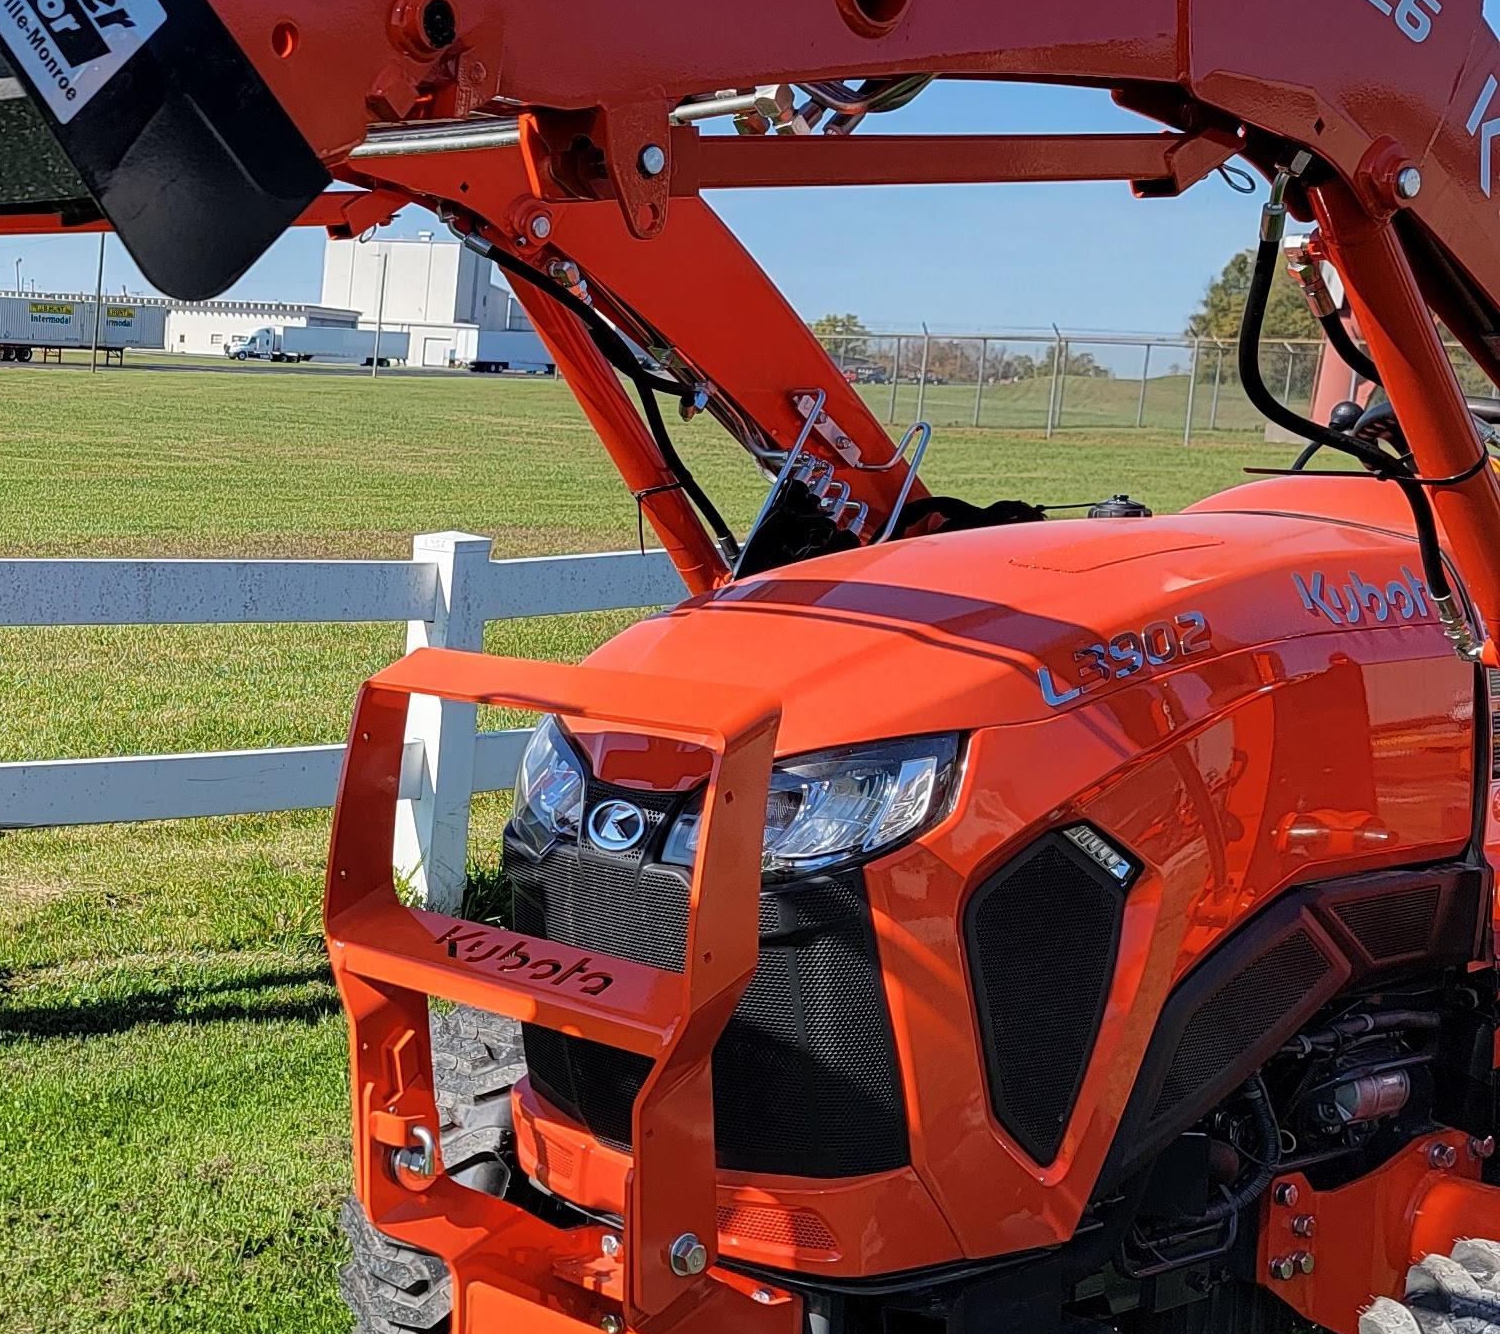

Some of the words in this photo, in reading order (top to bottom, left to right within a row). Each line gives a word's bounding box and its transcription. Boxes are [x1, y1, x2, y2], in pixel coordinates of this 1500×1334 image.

[31, 314, 71, 324] Intermodal
[1292, 565, 1430, 624] Kubot
[1037, 610, 1212, 707] L3902
[434, 924, 614, 996] Kubota
